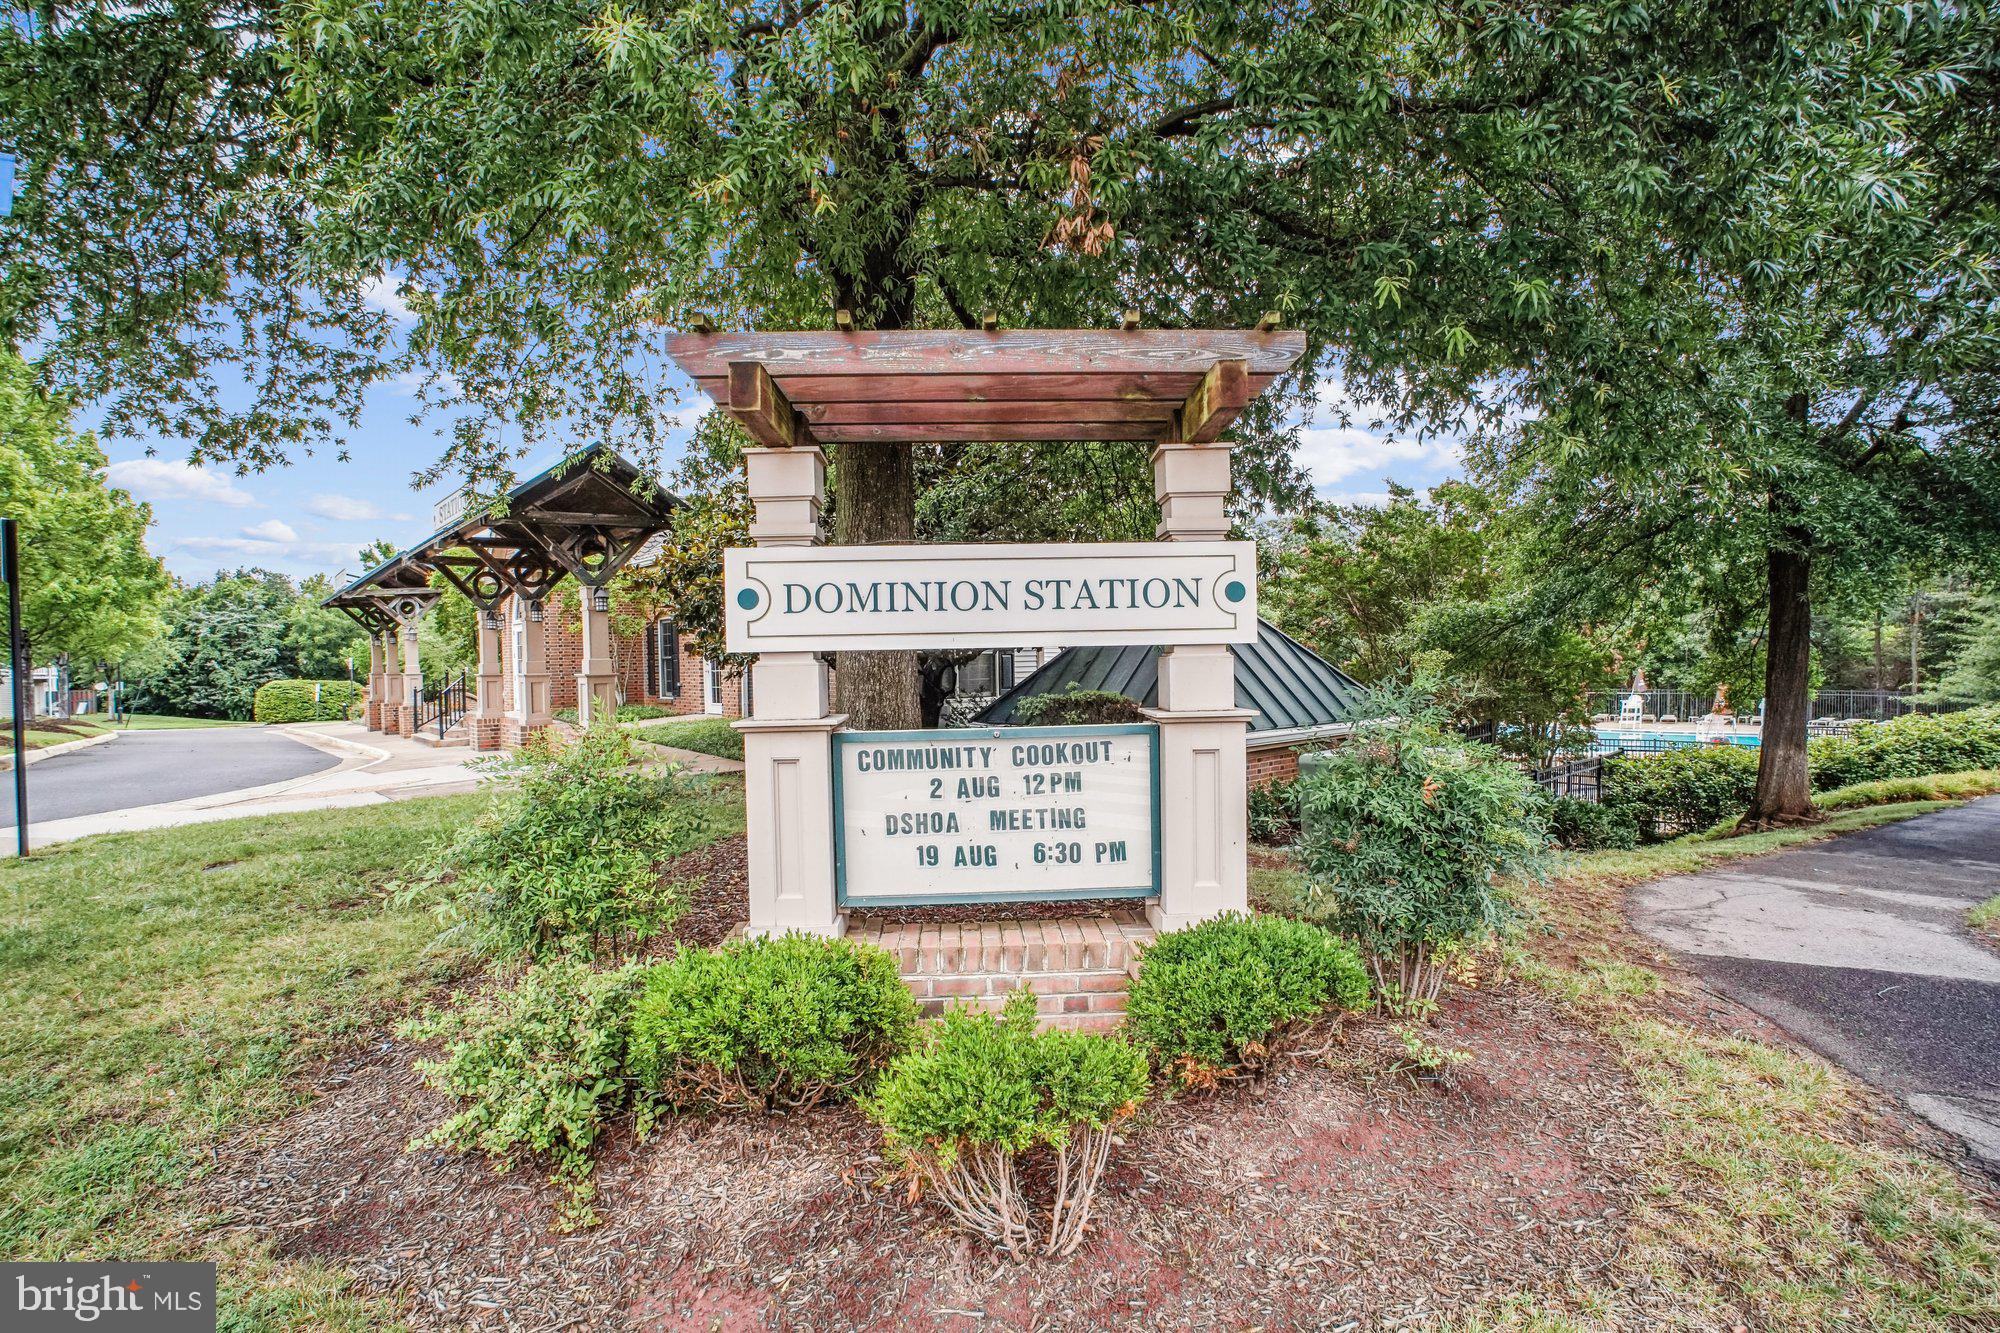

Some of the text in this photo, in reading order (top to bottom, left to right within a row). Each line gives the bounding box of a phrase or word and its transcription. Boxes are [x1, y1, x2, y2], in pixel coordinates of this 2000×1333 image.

[783, 577, 1203, 615] DOMINION STATION
[857, 740, 1113, 772] COMMUNITY COOKOUT
[929, 777, 943, 799] 2
[957, 775, 1000, 799] AUG
[885, 807, 1086, 836] DSHOA MEETING
[916, 840, 1127, 867] 19 AUG 6:30 PM
